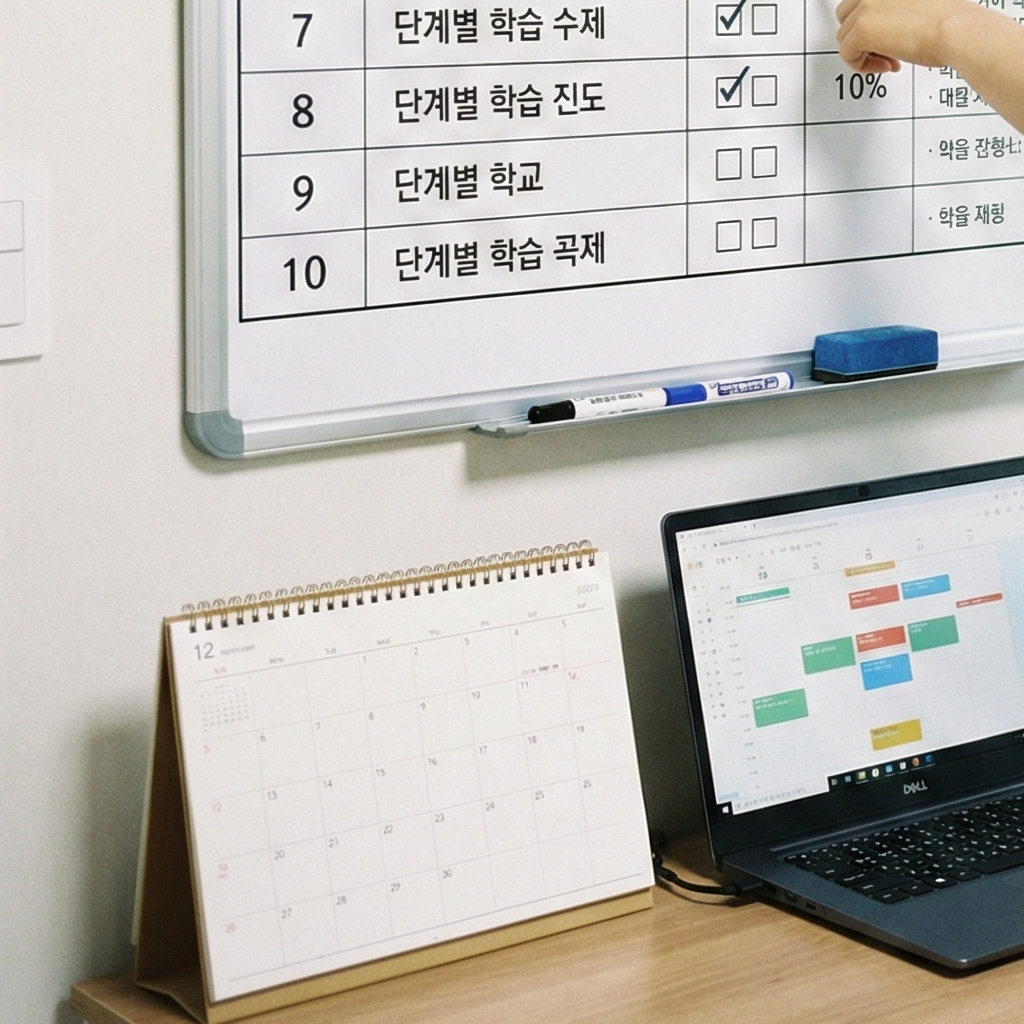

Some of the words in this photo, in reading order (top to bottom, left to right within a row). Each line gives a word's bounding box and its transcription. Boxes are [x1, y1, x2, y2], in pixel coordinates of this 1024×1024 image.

[292, 13, 313, 48] 7
[394, 8, 479, 45] 단계별
[489, 7, 544, 43] 학습
[552, 5, 605, 41] 수제
[395, 85, 478, 124] 단계별
[489, 83, 544, 120] 학습
[553, 82, 606, 116] 진도
[835, 71, 886, 100] 10%
[292, 93, 315, 129] 8
[292, 174, 314, 212] 9
[395, 163, 479, 203] 단계별
[489, 161, 544, 197] 학교
[283, 254, 327, 292] 10
[395, 241, 479, 282] 단계별
[489, 237, 544, 273] 학습
[552, 230, 605, 268] 곡제
[194, 642, 214, 660] 12
